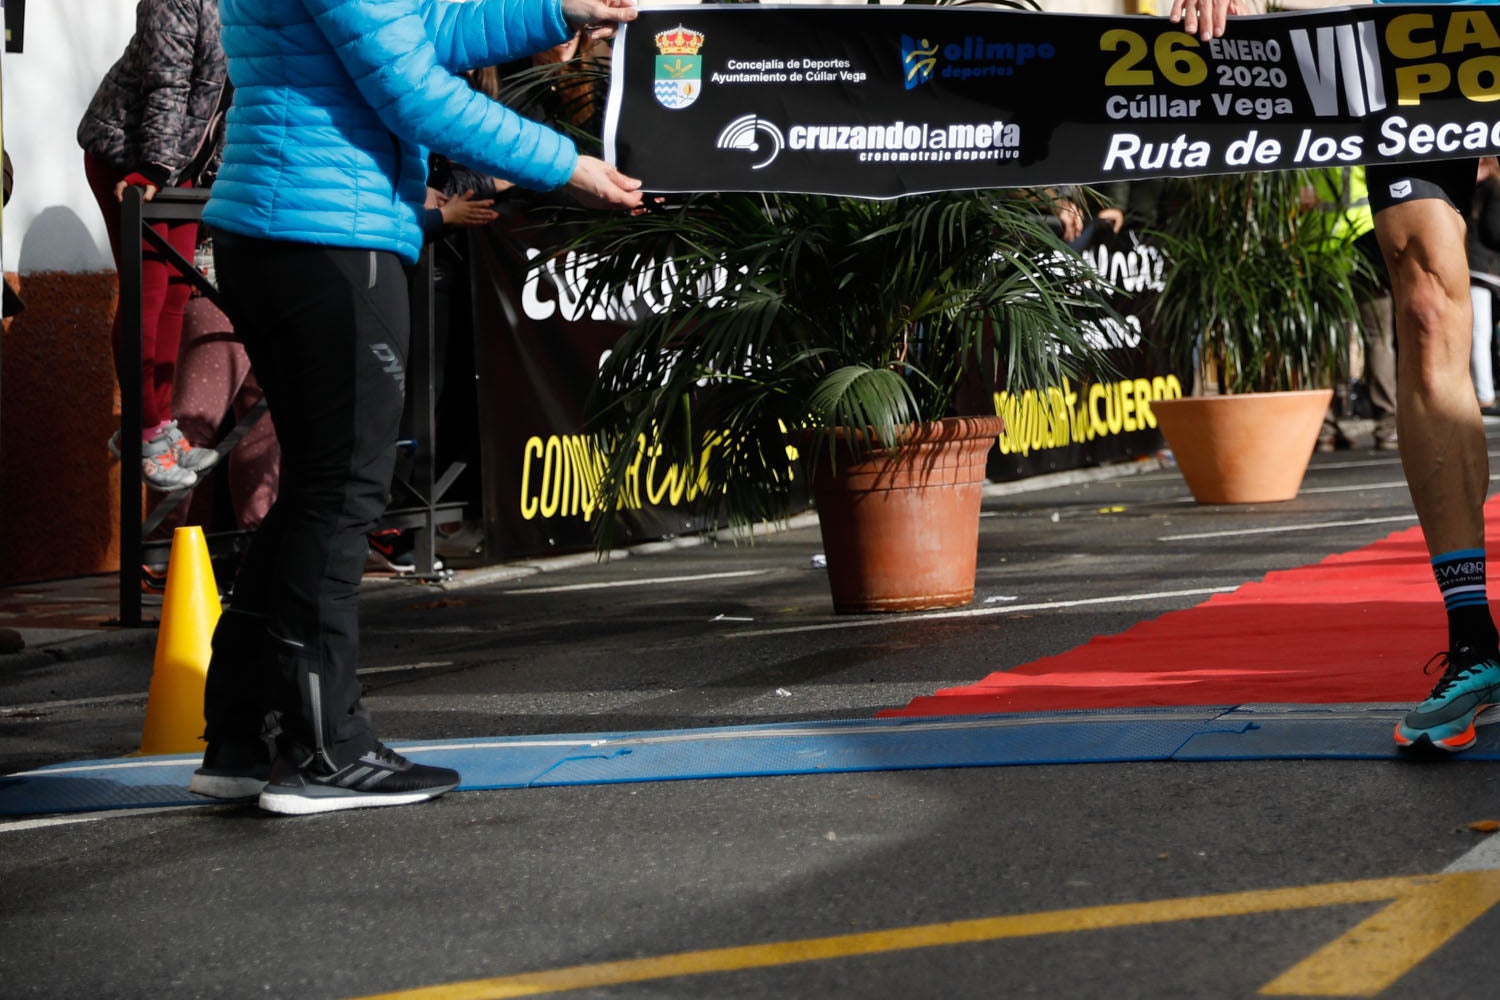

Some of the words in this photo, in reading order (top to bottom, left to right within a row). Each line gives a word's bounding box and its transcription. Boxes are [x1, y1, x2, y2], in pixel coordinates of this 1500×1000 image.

[942, 35, 1056, 65] olimpo
[1100, 29, 1208, 87] 26
[1209, 38, 1282, 63] ENERO
[711, 71, 787, 84] Ayuntamiento
[789, 72, 804, 82] de
[805, 69, 838, 83] Cúllar
[839, 70, 867, 84] Vega
[727, 59, 784, 72] Concejalía
[786, 60, 800, 70] de
[802, 58, 851, 72] Deportes
[941, 64, 1015, 80] deportes
[1216, 65, 1288, 88] 2020
[1289, 19, 1387, 117] VII
[1105, 95, 1201, 120] Cúllar
[1211, 93, 1294, 120] Vega
[789, 119, 1021, 150] cruzandolameta
[859, 150, 952, 162] cronometraje
[954, 148, 1021, 161] deportivo
[1103, 133, 1211, 171] Ruta
[1225, 130, 1282, 165] de
[1293, 129, 1365, 163] los
